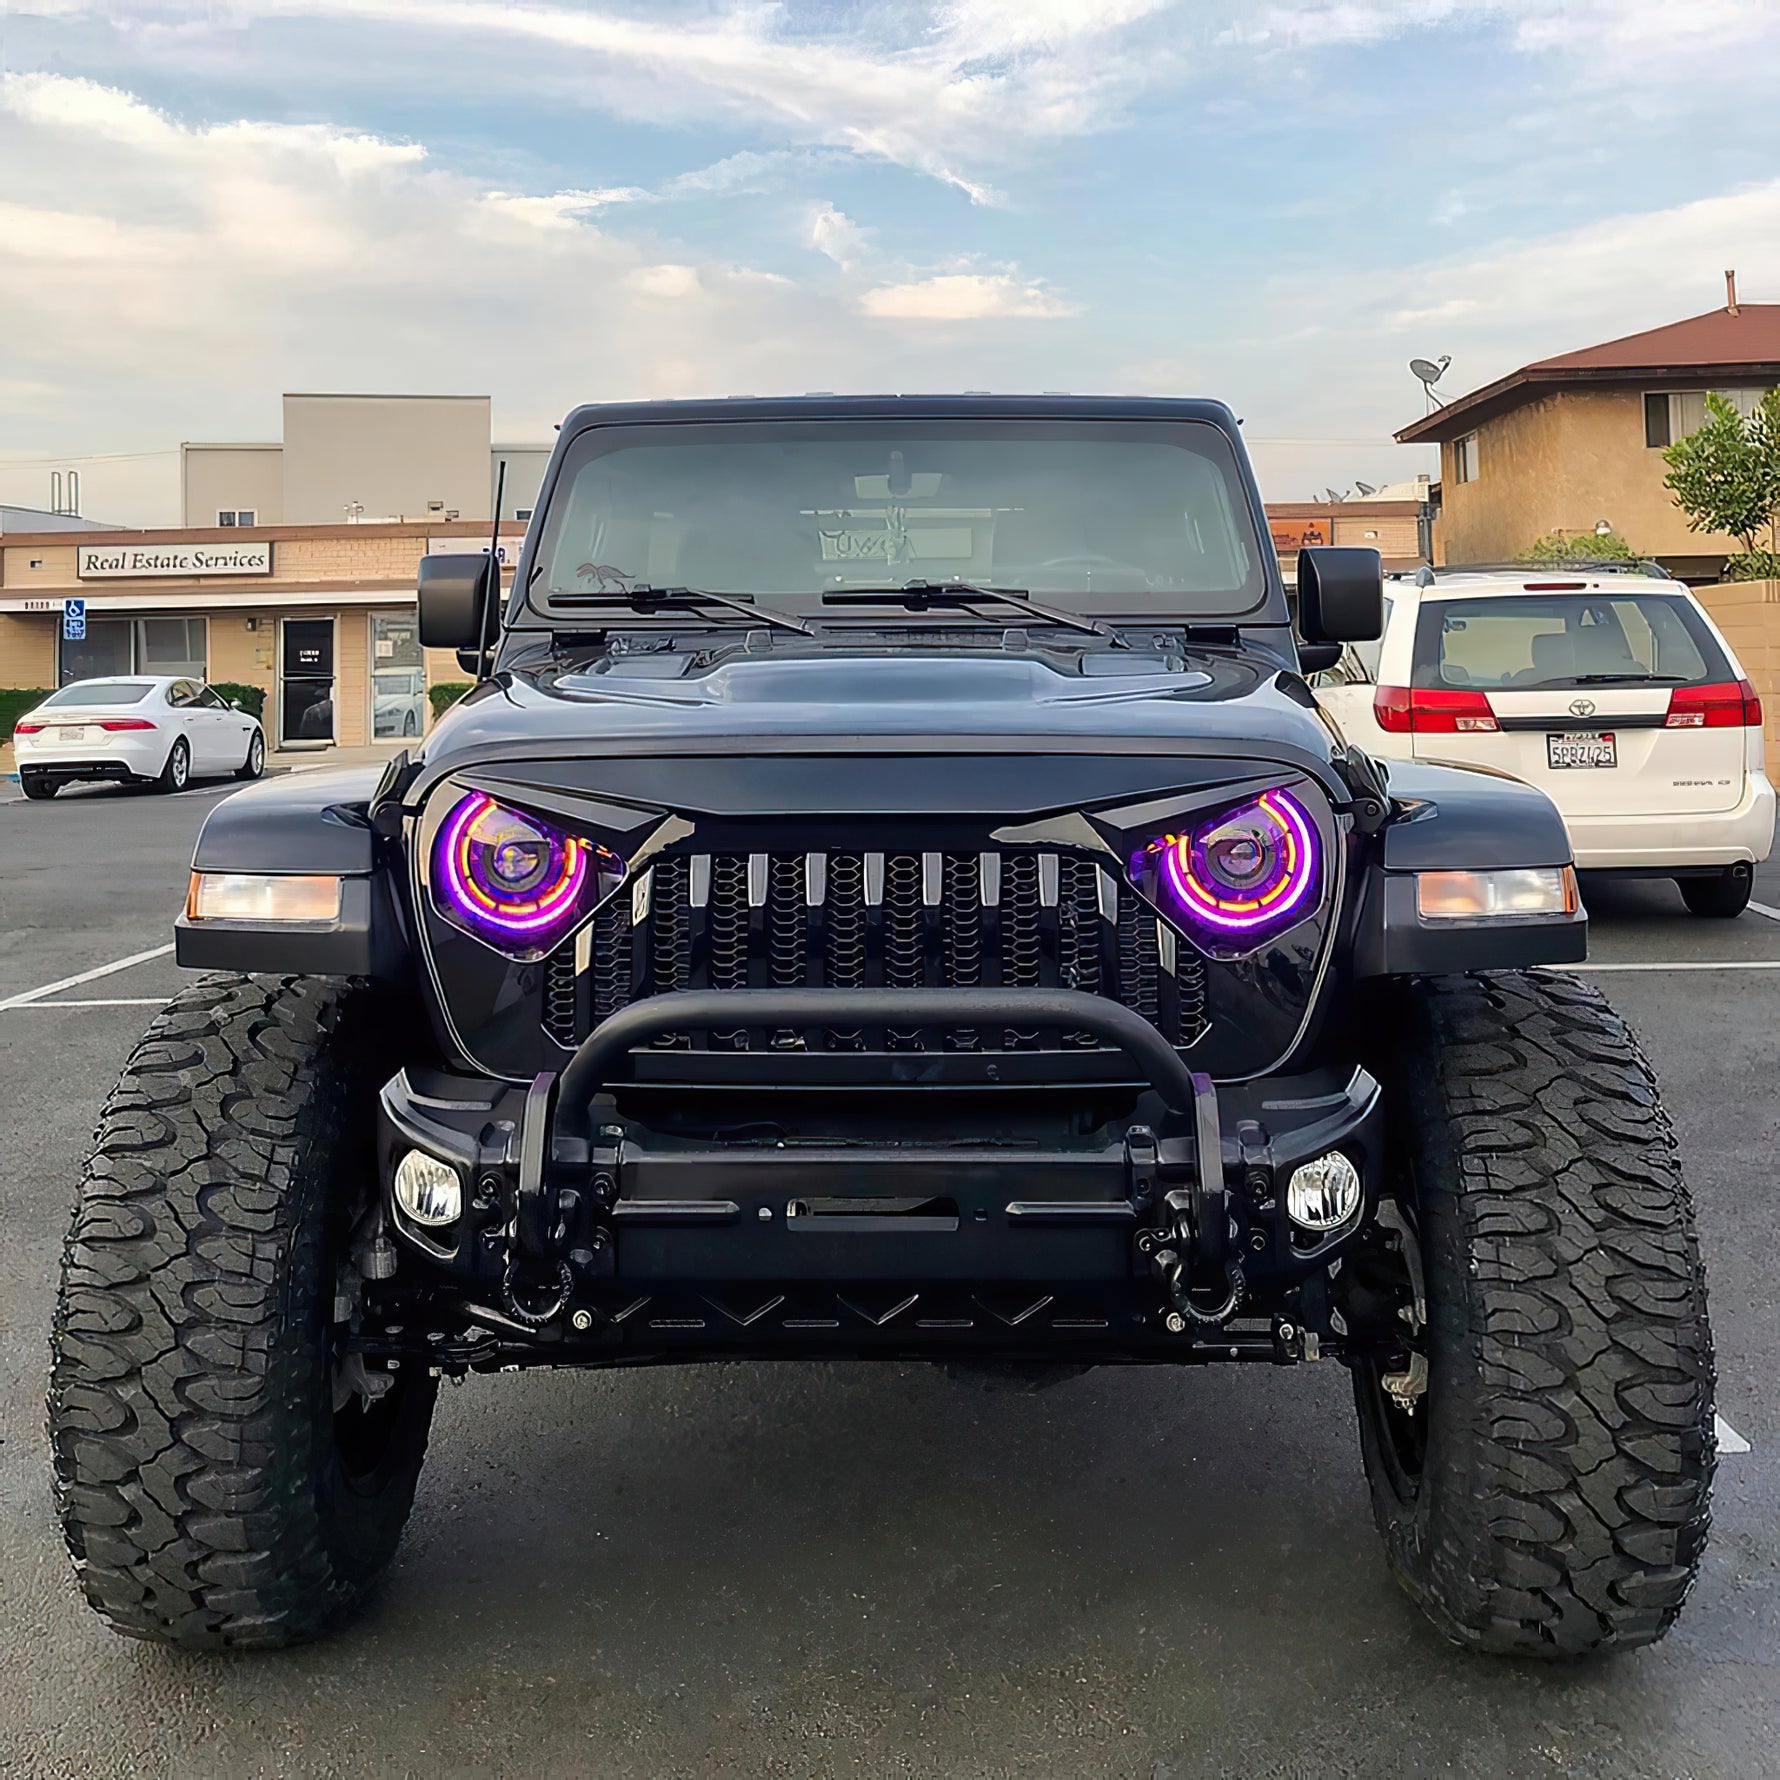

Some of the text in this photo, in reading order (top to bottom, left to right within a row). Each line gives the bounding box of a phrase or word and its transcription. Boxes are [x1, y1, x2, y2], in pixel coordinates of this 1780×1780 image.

[85, 551, 265, 571] Real Estate Services
